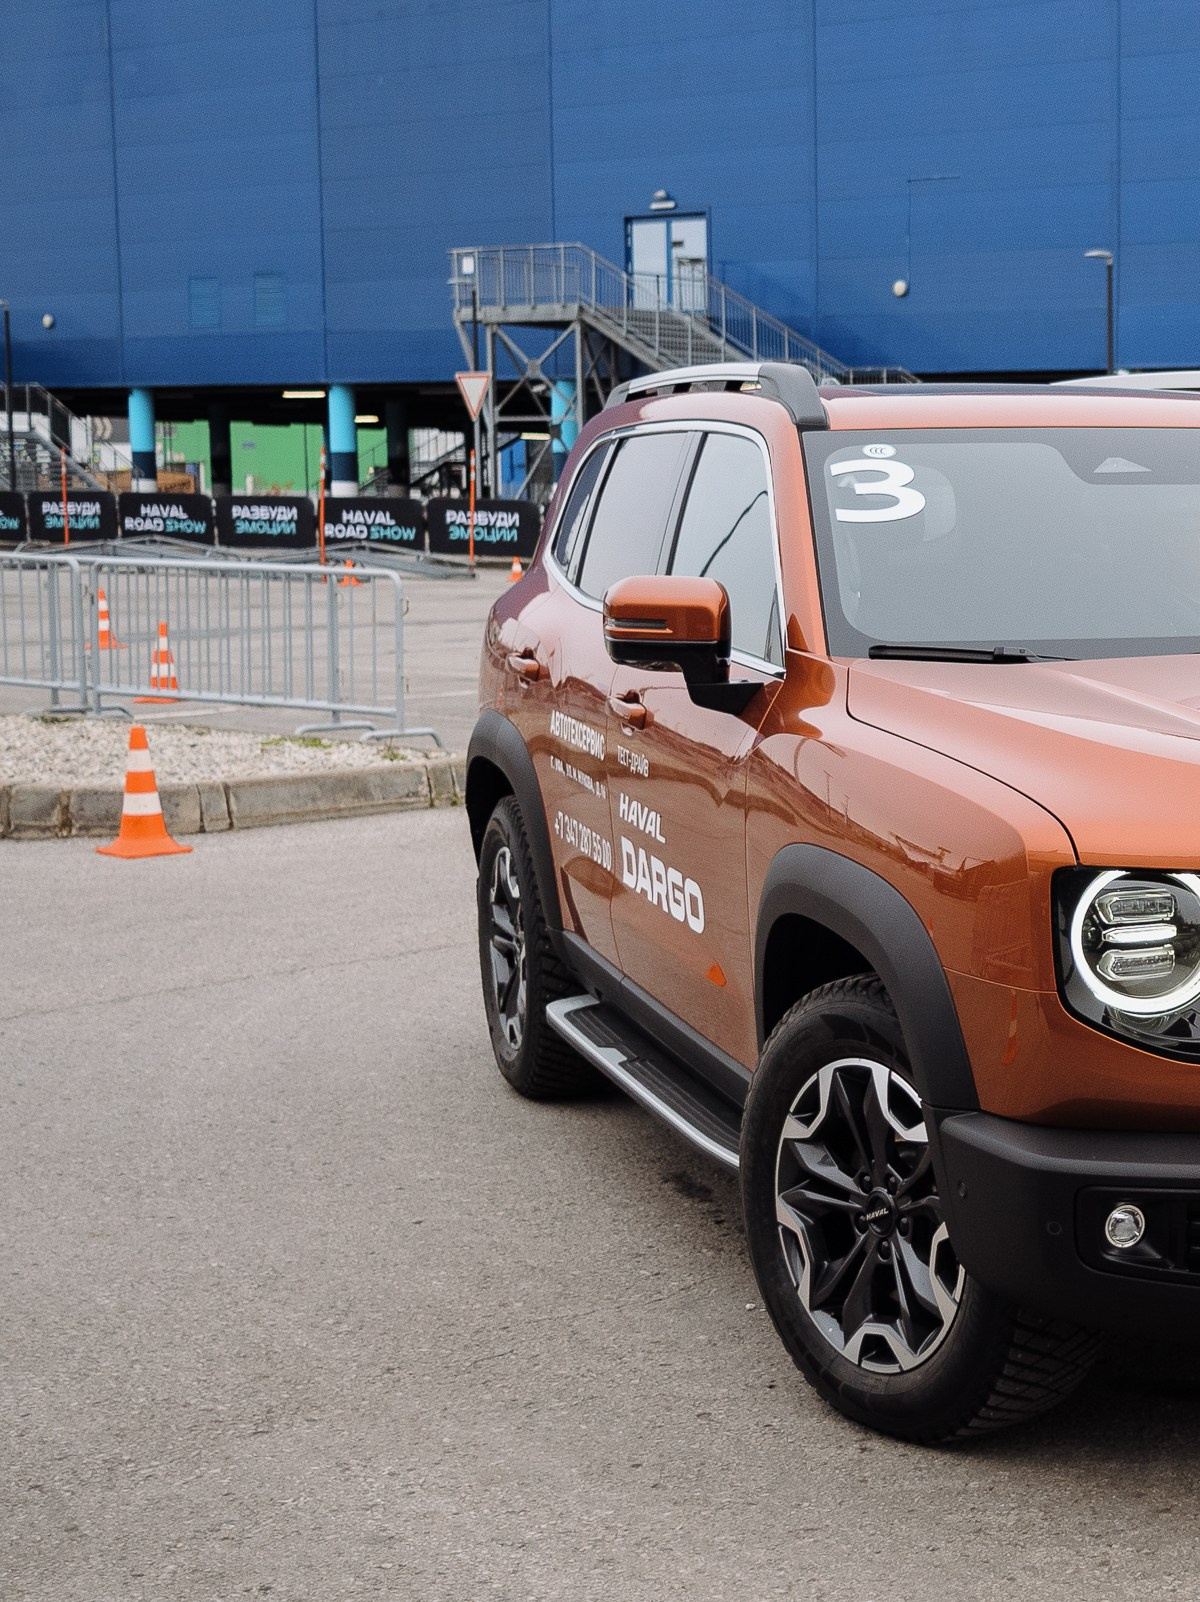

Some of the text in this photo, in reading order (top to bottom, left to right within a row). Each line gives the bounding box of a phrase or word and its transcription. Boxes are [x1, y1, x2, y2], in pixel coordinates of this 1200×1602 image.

[830, 458, 926, 523] 3
[140, 503, 189, 519] HAVAL
[231, 505, 298, 521] РАЗБУДИ
[342, 509, 396, 525] HAVAL
[124, 516, 206, 534] ROAD SHOW
[235, 519, 296, 536] ЭМОЦИИ
[324, 523, 416, 541] ROAD SHOW
[550, 709, 605, 761] АВТОТЕХСЕРВИС
[619, 792, 666, 844] HAVAL
[621, 835, 705, 934] DARGO
[866, 1207, 889, 1221] HAVAL
